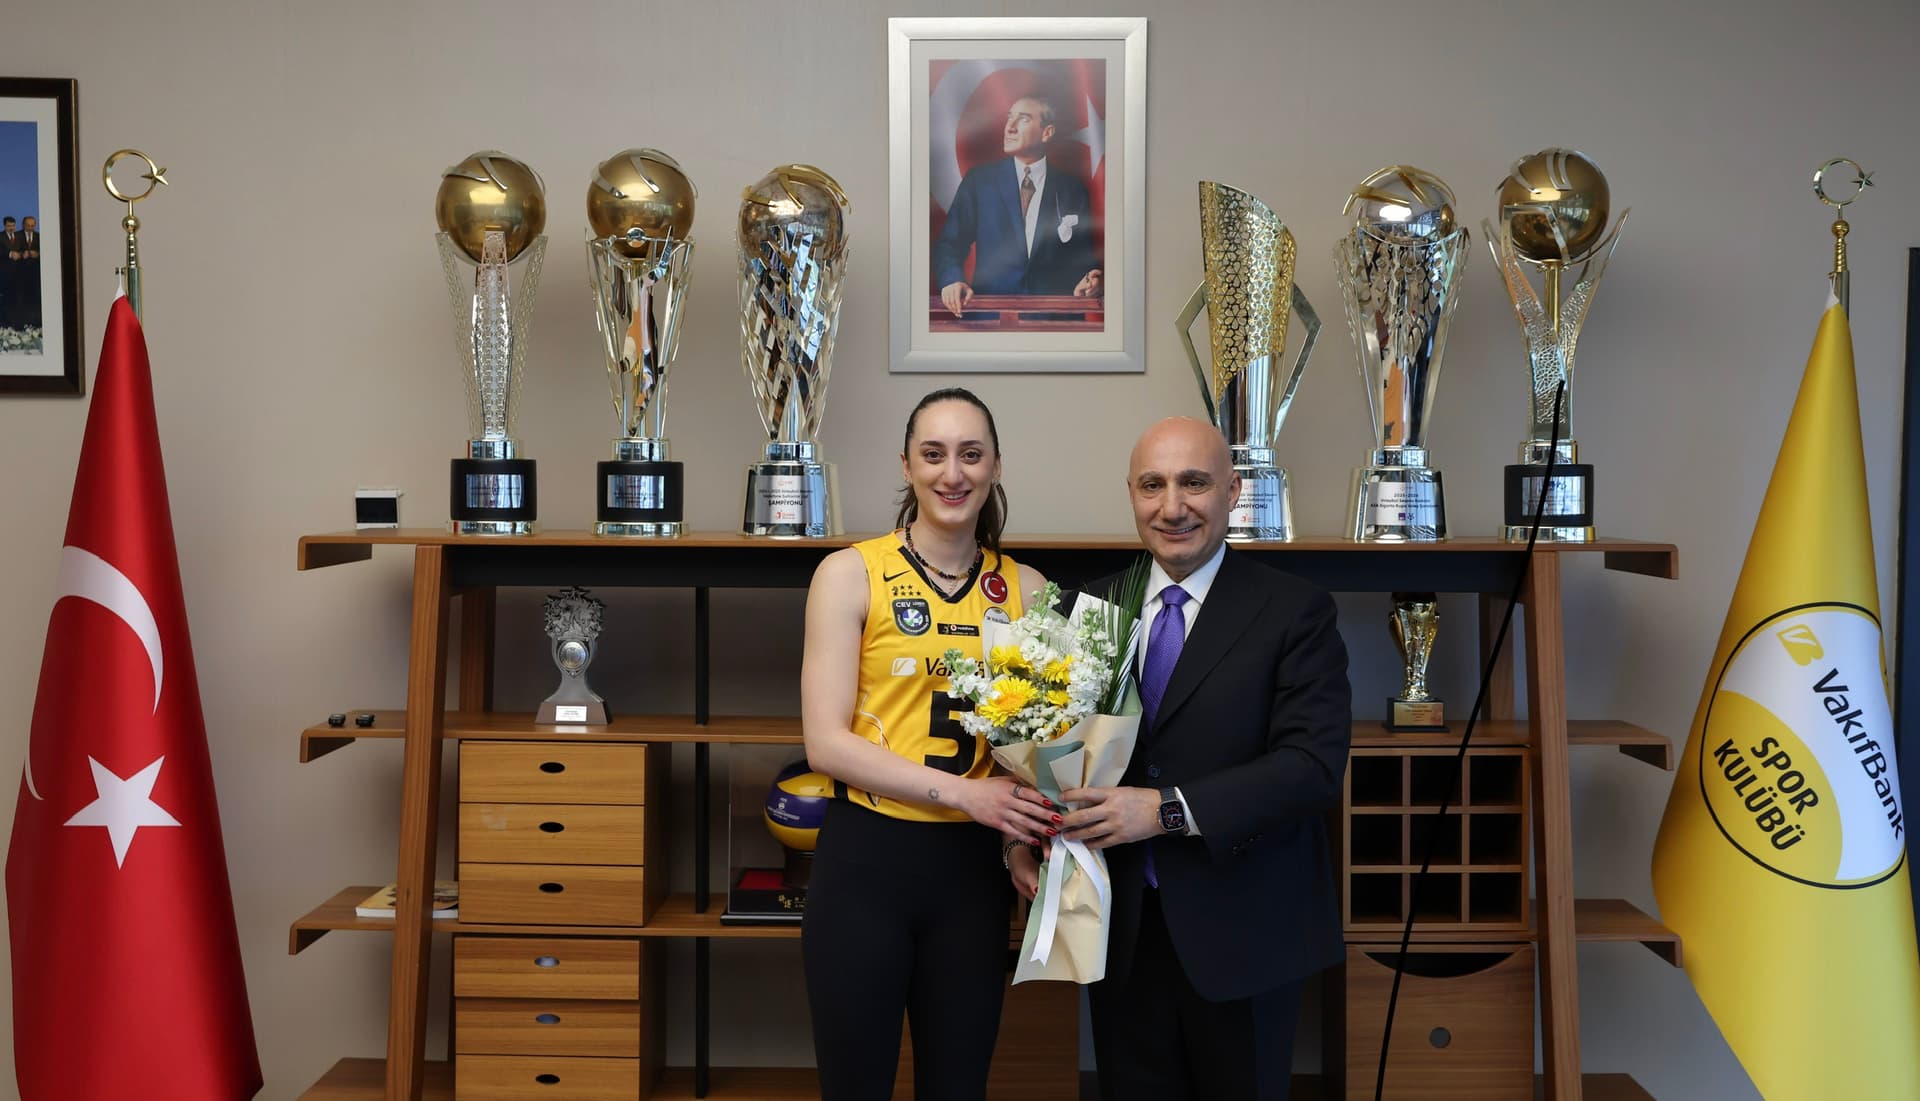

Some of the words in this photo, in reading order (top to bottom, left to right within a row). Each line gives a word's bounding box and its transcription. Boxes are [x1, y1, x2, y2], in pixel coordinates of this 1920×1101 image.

[924, 690, 976, 777] 5
[1750, 736, 1820, 816] SPOR
[1713, 738, 1807, 851] KULÜBÜ
